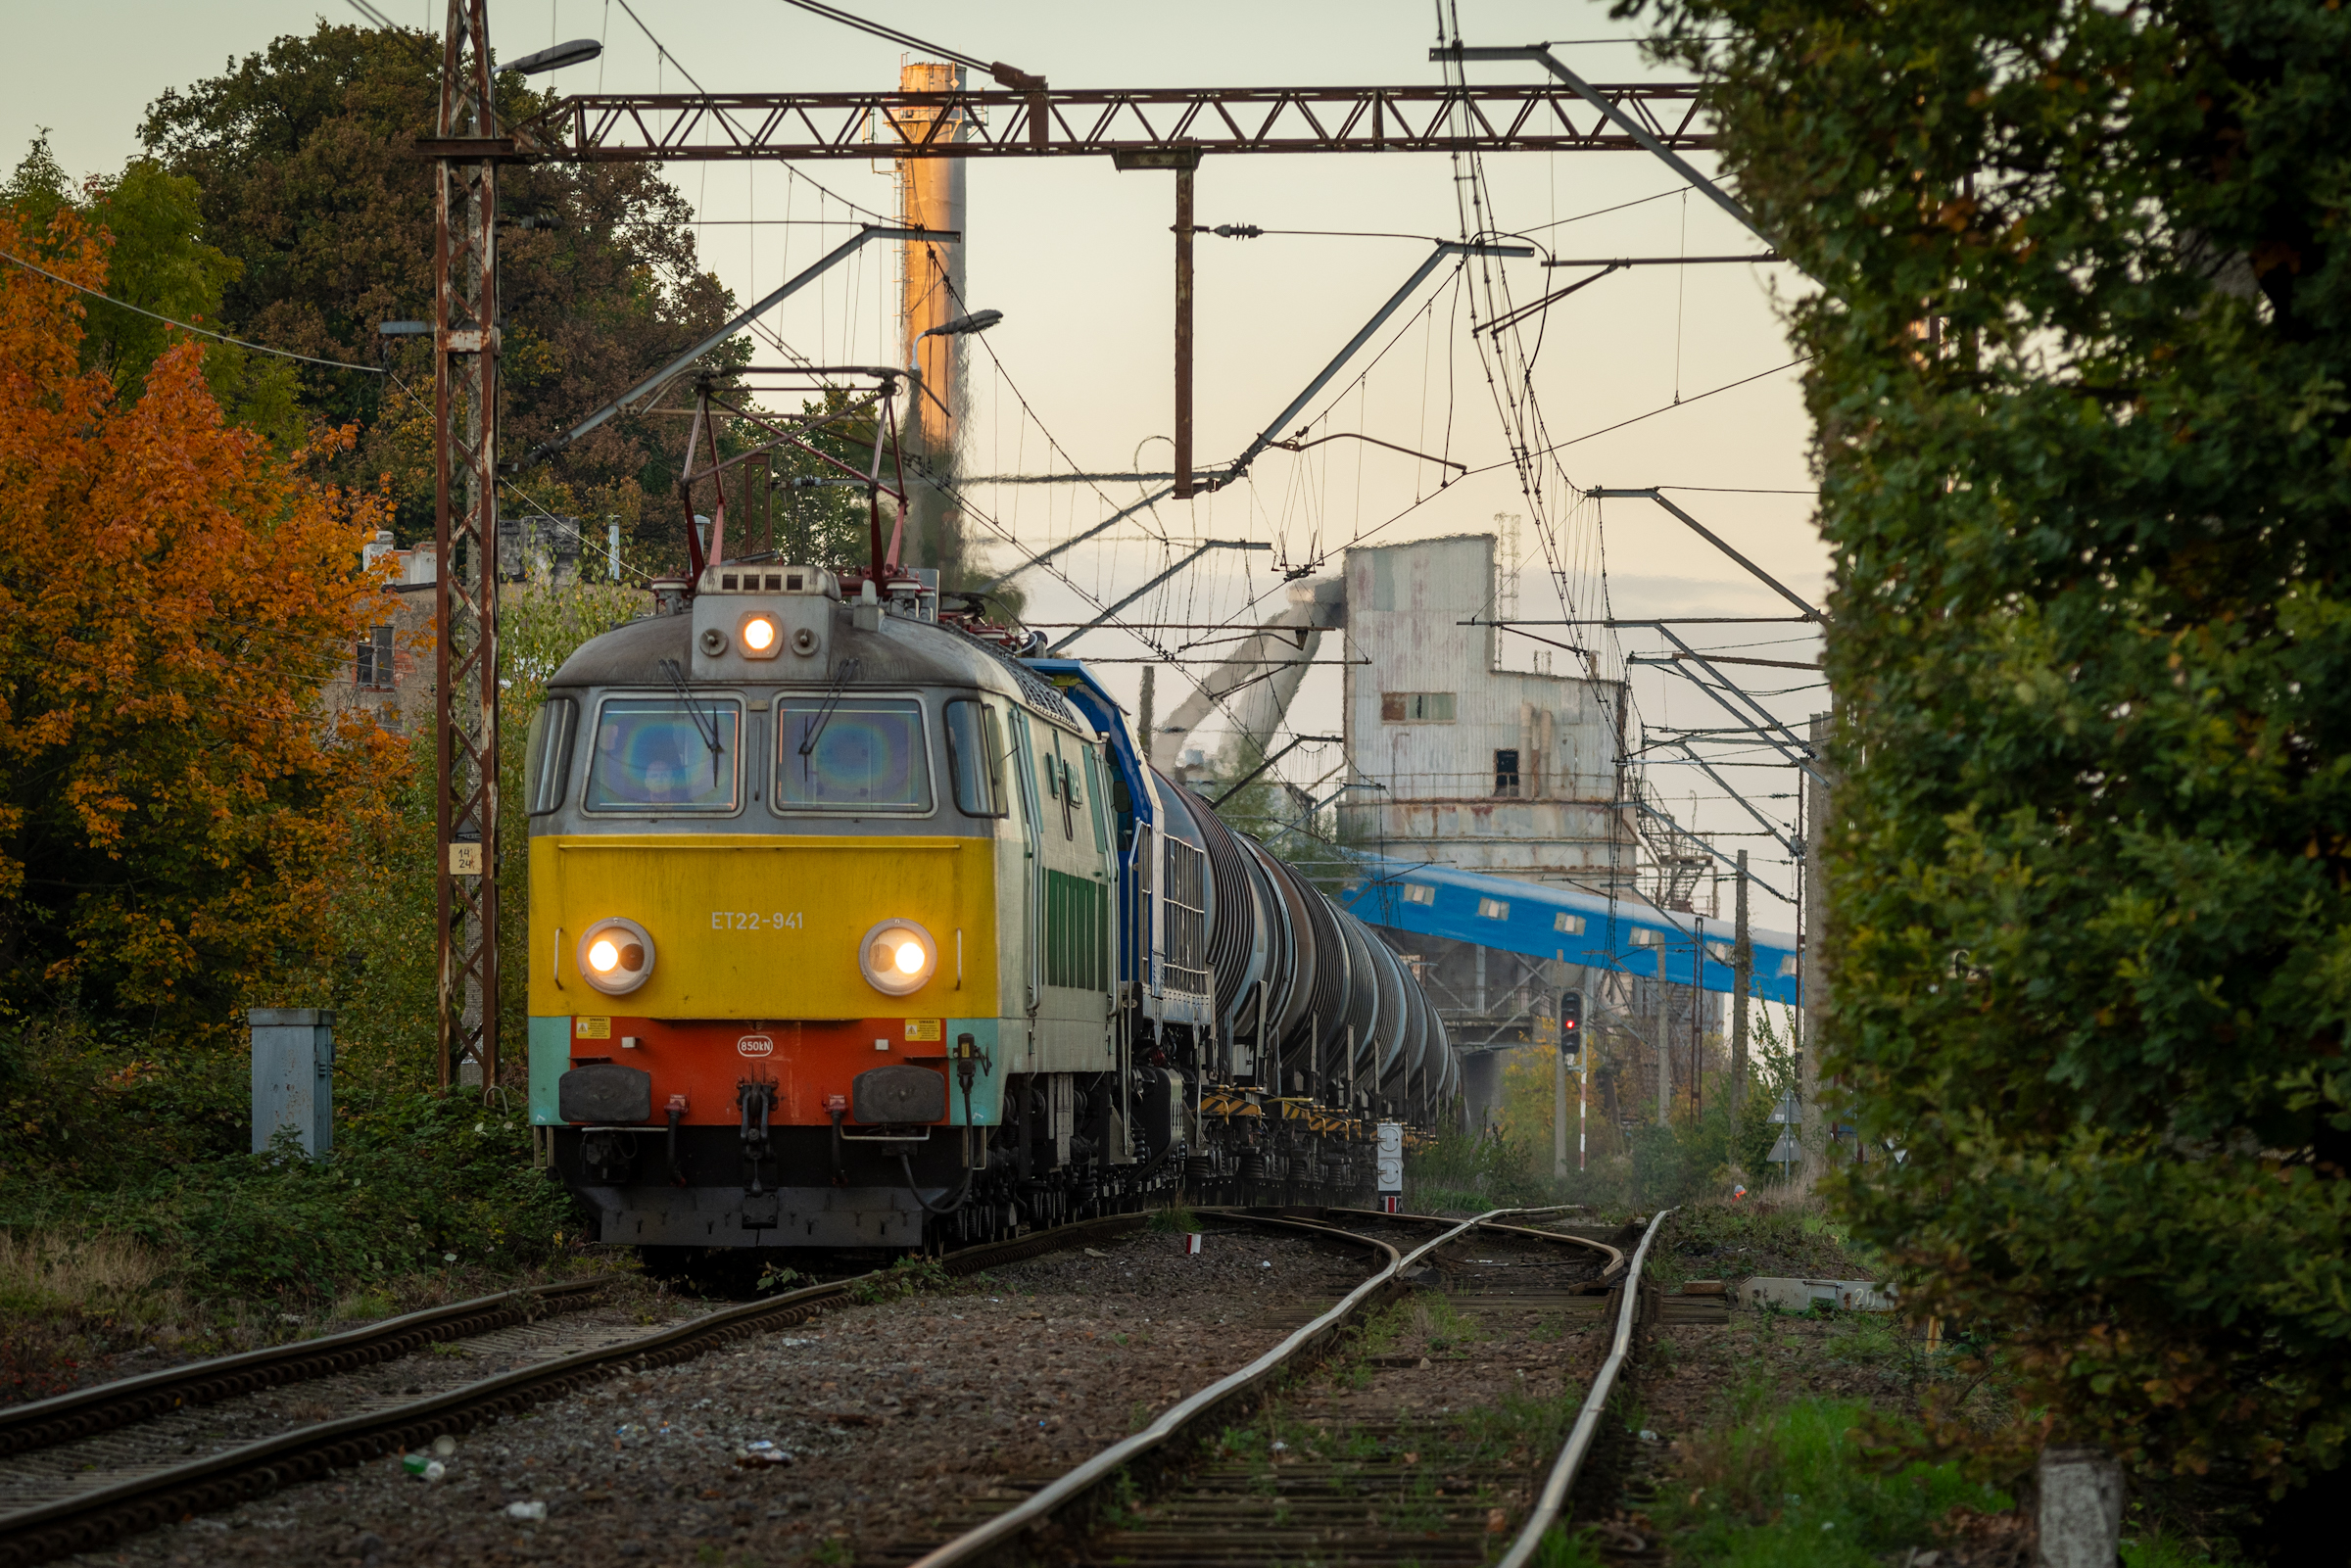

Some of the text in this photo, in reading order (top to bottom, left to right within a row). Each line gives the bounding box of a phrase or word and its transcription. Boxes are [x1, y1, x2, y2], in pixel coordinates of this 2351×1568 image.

[458, 848, 470, 858] 14
[459, 859, 471, 869] 24
[711, 912, 802, 929] ET22-941
[741, 1041, 771, 1051] 850kN
[1854, 1288, 1876, 1307] 20
